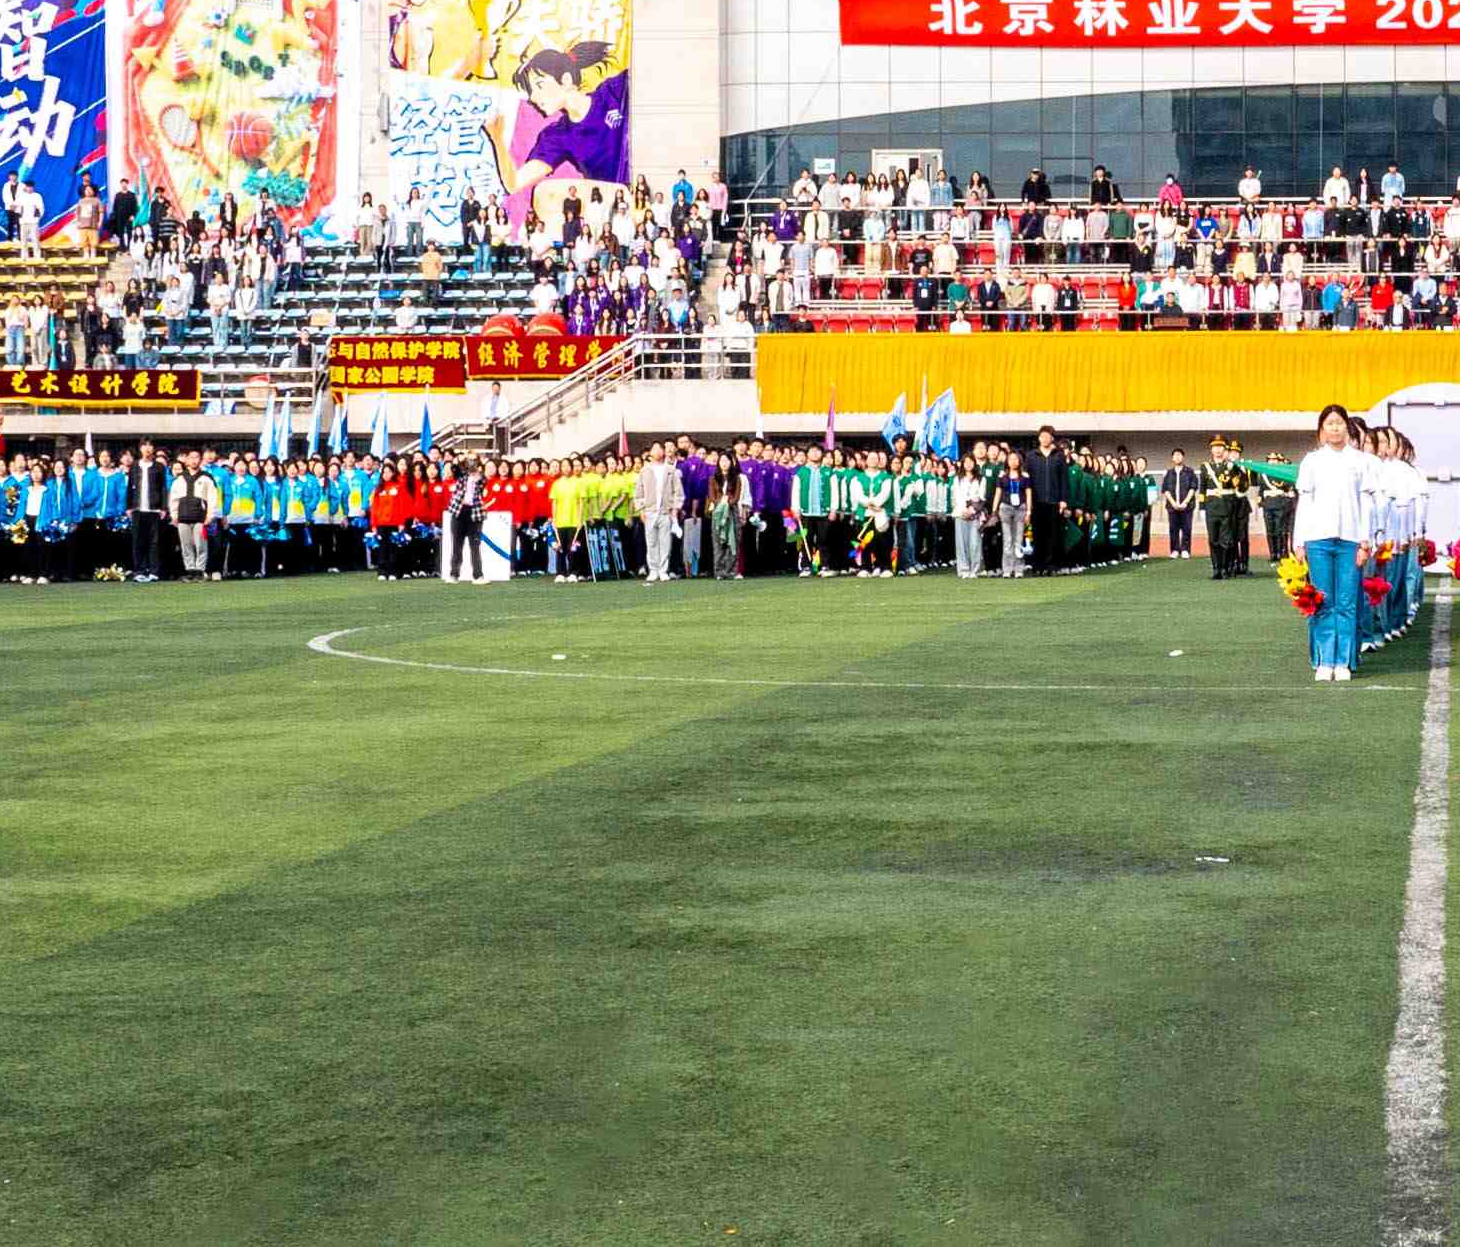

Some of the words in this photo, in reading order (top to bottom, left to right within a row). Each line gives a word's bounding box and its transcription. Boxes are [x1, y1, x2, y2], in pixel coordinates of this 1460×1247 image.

[11, 370, 180, 396] 艺术设计学院
